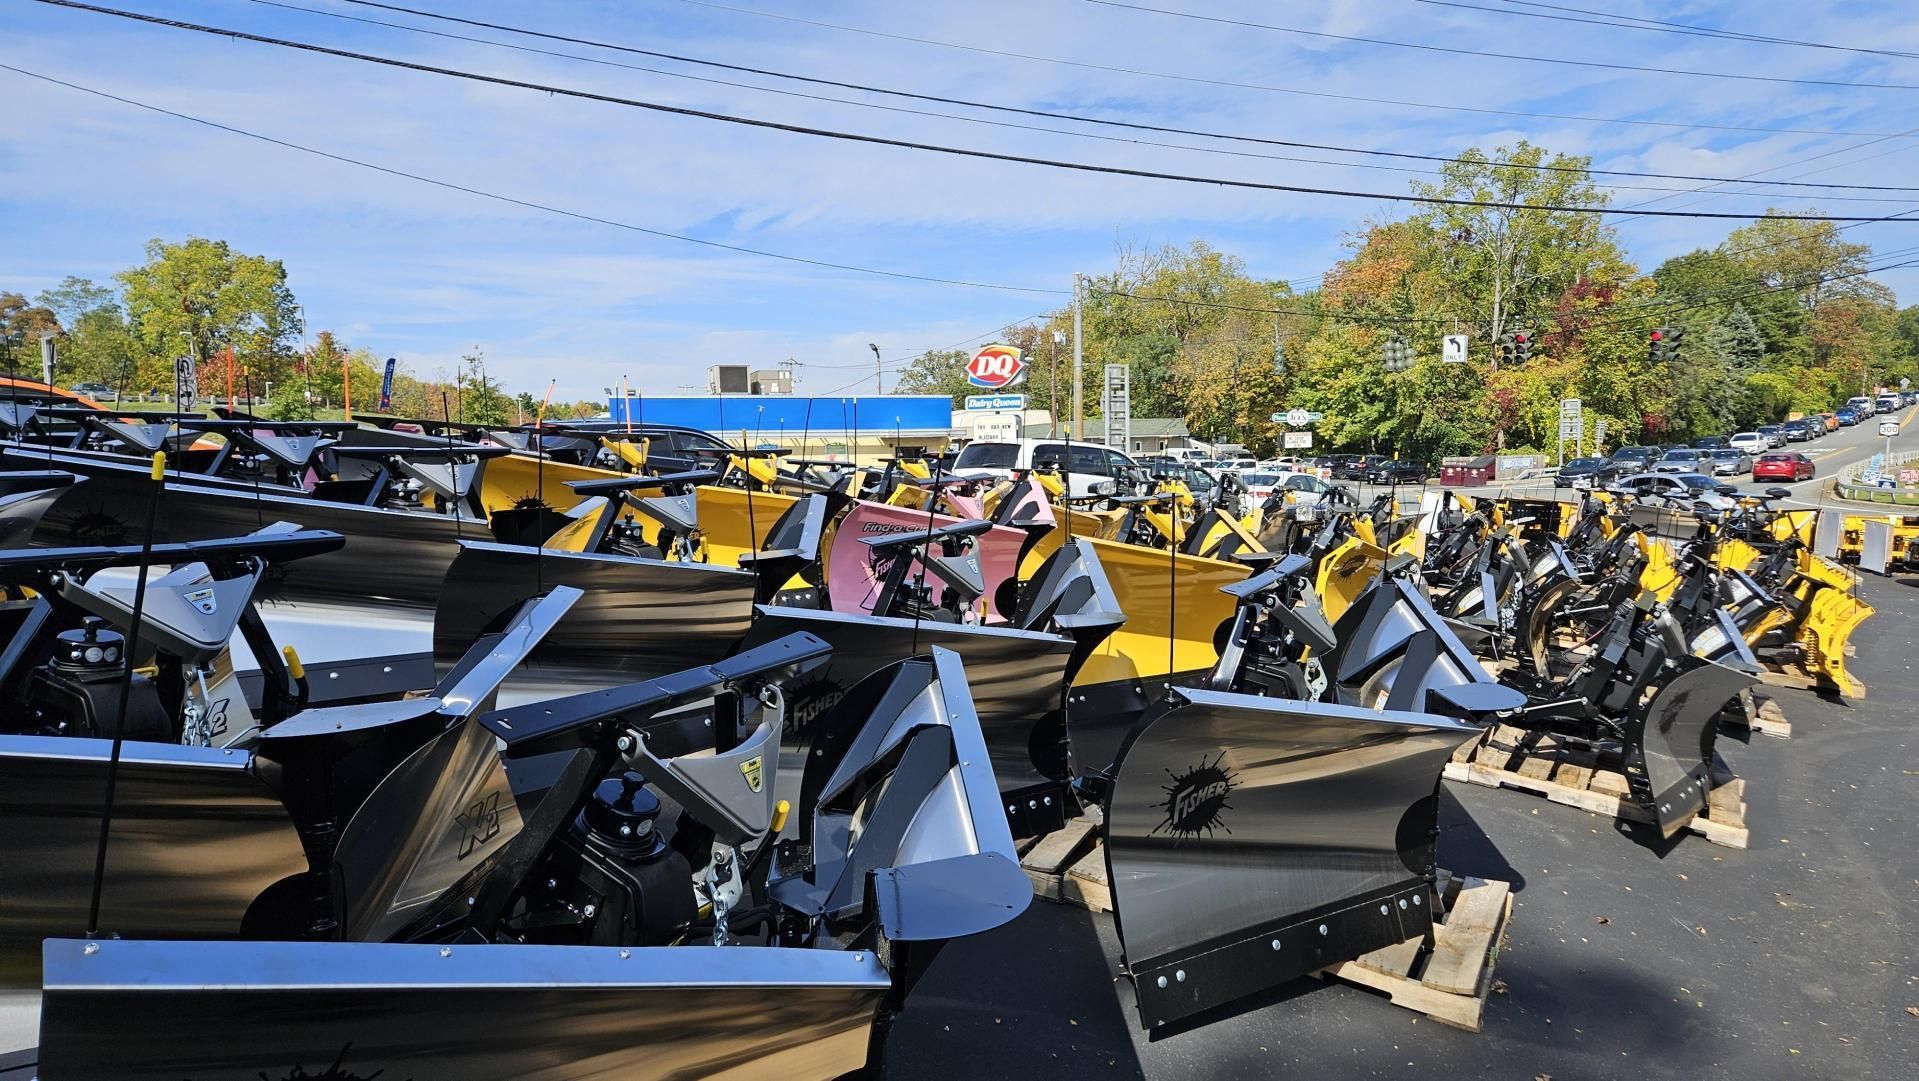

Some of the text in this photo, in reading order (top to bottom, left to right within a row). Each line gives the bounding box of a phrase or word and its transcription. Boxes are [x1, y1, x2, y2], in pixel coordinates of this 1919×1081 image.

[975, 354, 1014, 378] DQ
[968, 398, 1021, 408] Dairy Queen
[863, 521, 892, 533] Find
[1173, 781, 1227, 825] FISHER
